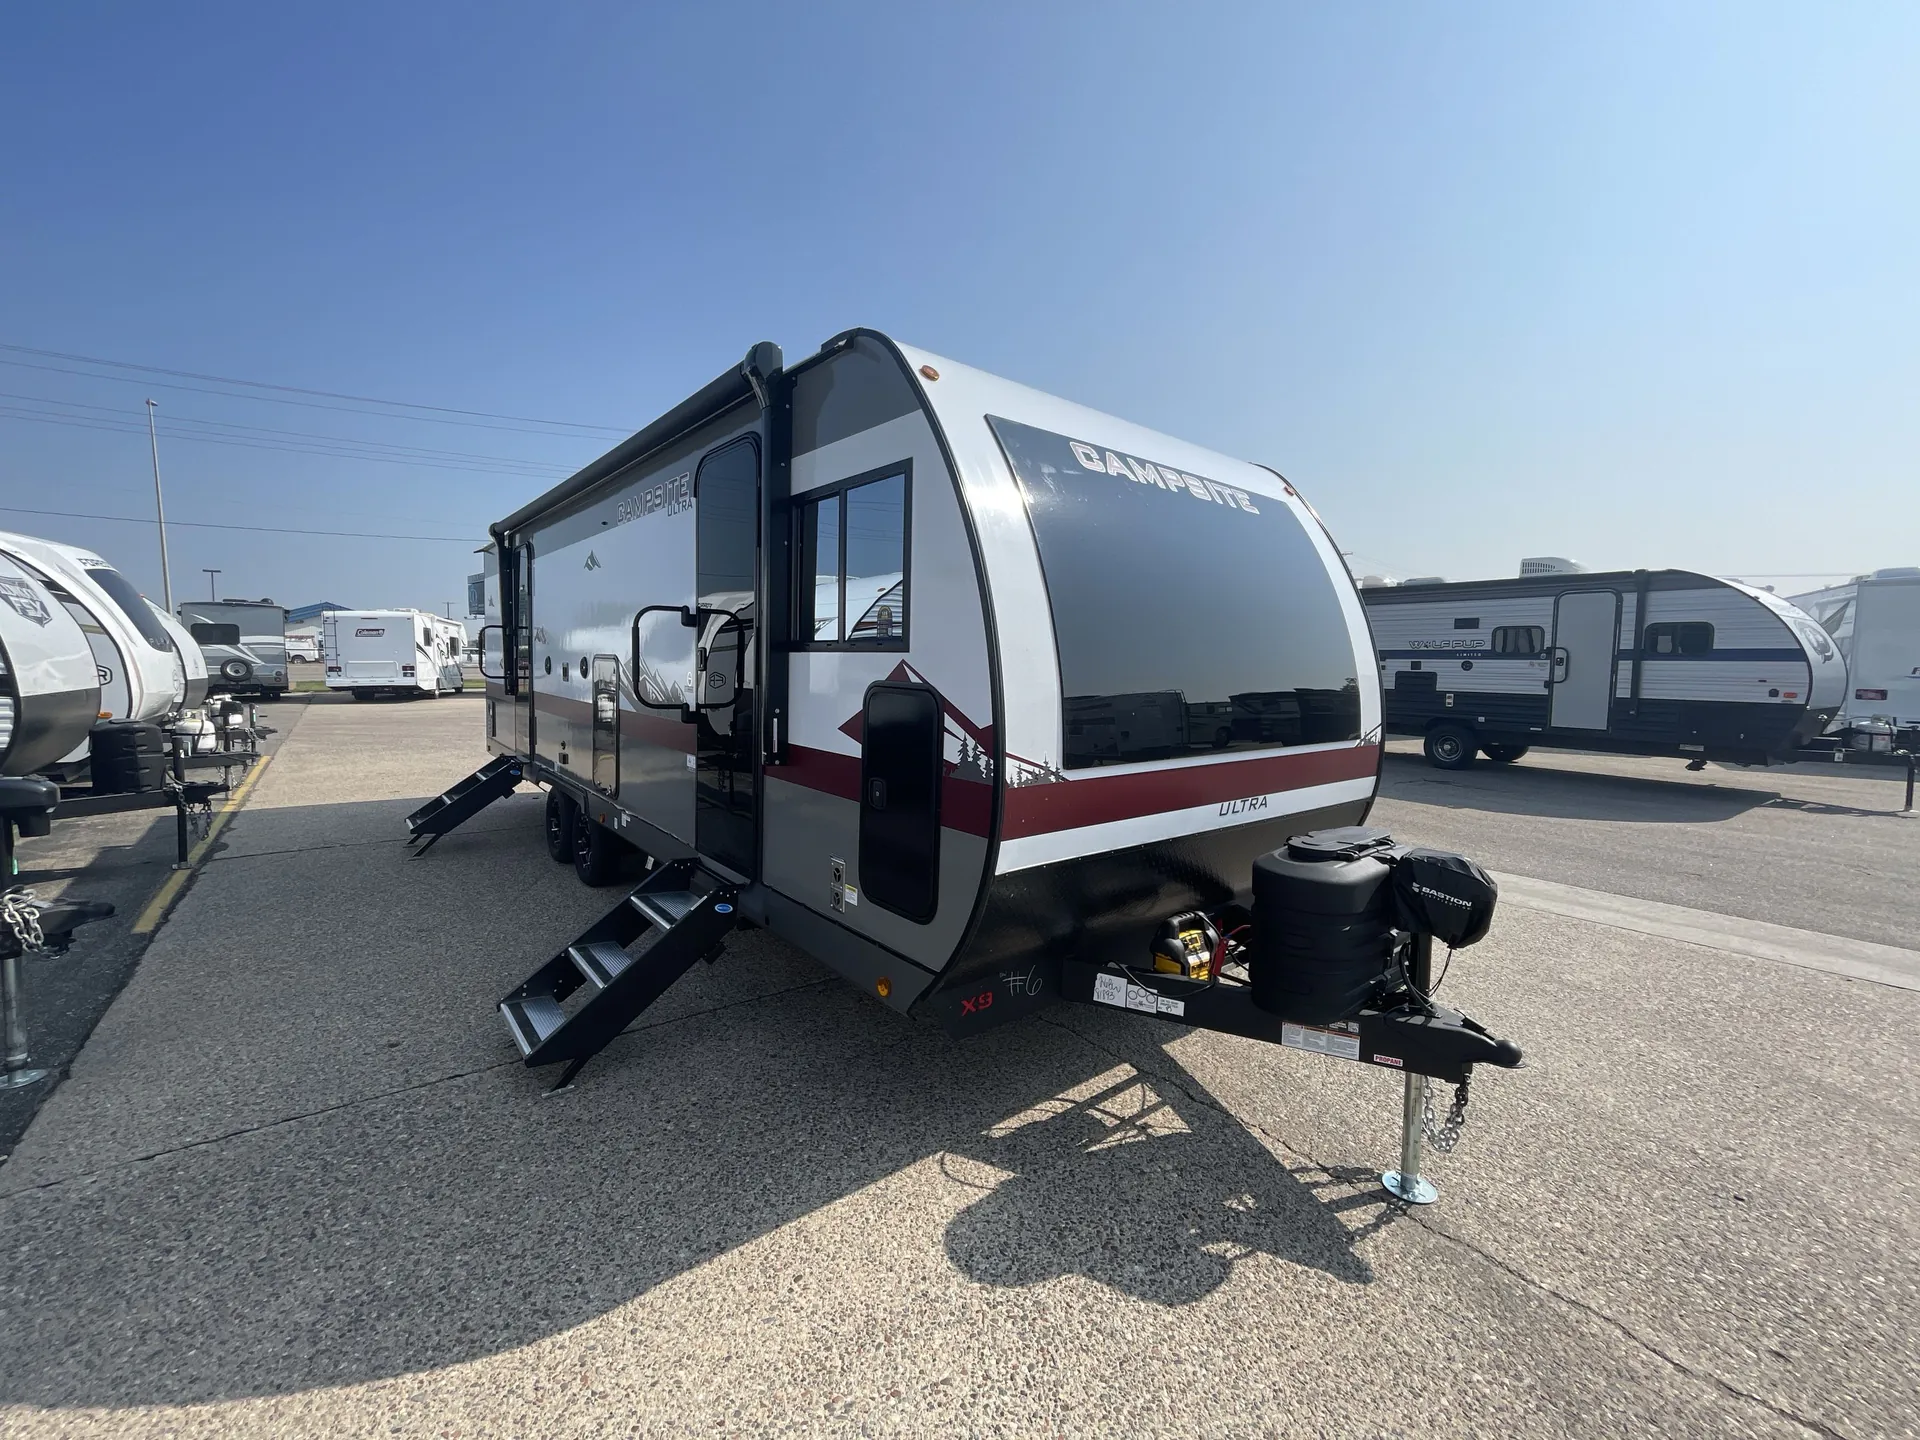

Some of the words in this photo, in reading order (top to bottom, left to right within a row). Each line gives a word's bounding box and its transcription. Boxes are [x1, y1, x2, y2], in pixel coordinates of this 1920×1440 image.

[1069, 441, 1260, 515] CAMPSITE
[616, 471, 690, 525] CAMPSITE
[667, 498, 693, 517] ULTRA
[357, 628, 379, 636] Coleman
[1451, 640, 1486, 649] PUP
[1219, 796, 1267, 816] ULTRA
[1422, 886, 1472, 907] BASTION
[1374, 1055, 1402, 1066] PROPANE
